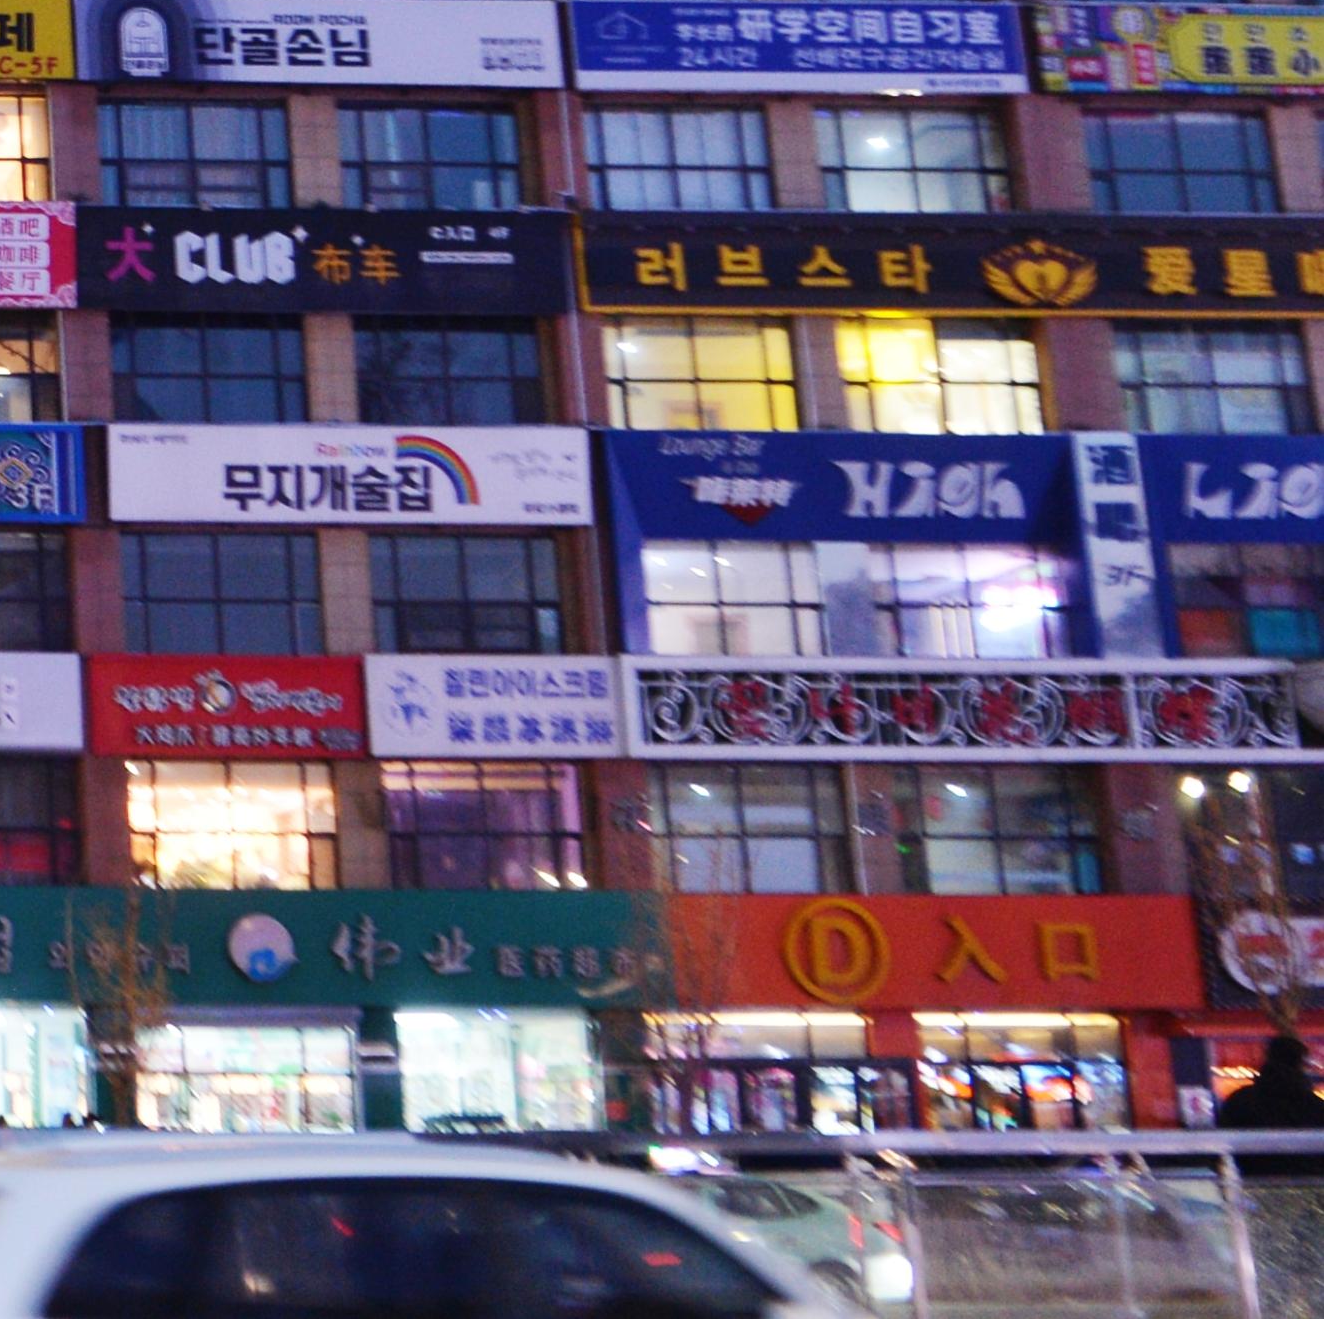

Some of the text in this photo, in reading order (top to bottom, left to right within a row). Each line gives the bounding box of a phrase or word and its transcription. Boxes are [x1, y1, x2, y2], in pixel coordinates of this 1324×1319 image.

[193, 27, 372, 68] 단골손님
[173, 230, 297, 285] CLUB
[635, 240, 935, 295] 러브스타
[223, 463, 434, 513] 무지개술집
[806, 914, 1100, 983] D 入口
